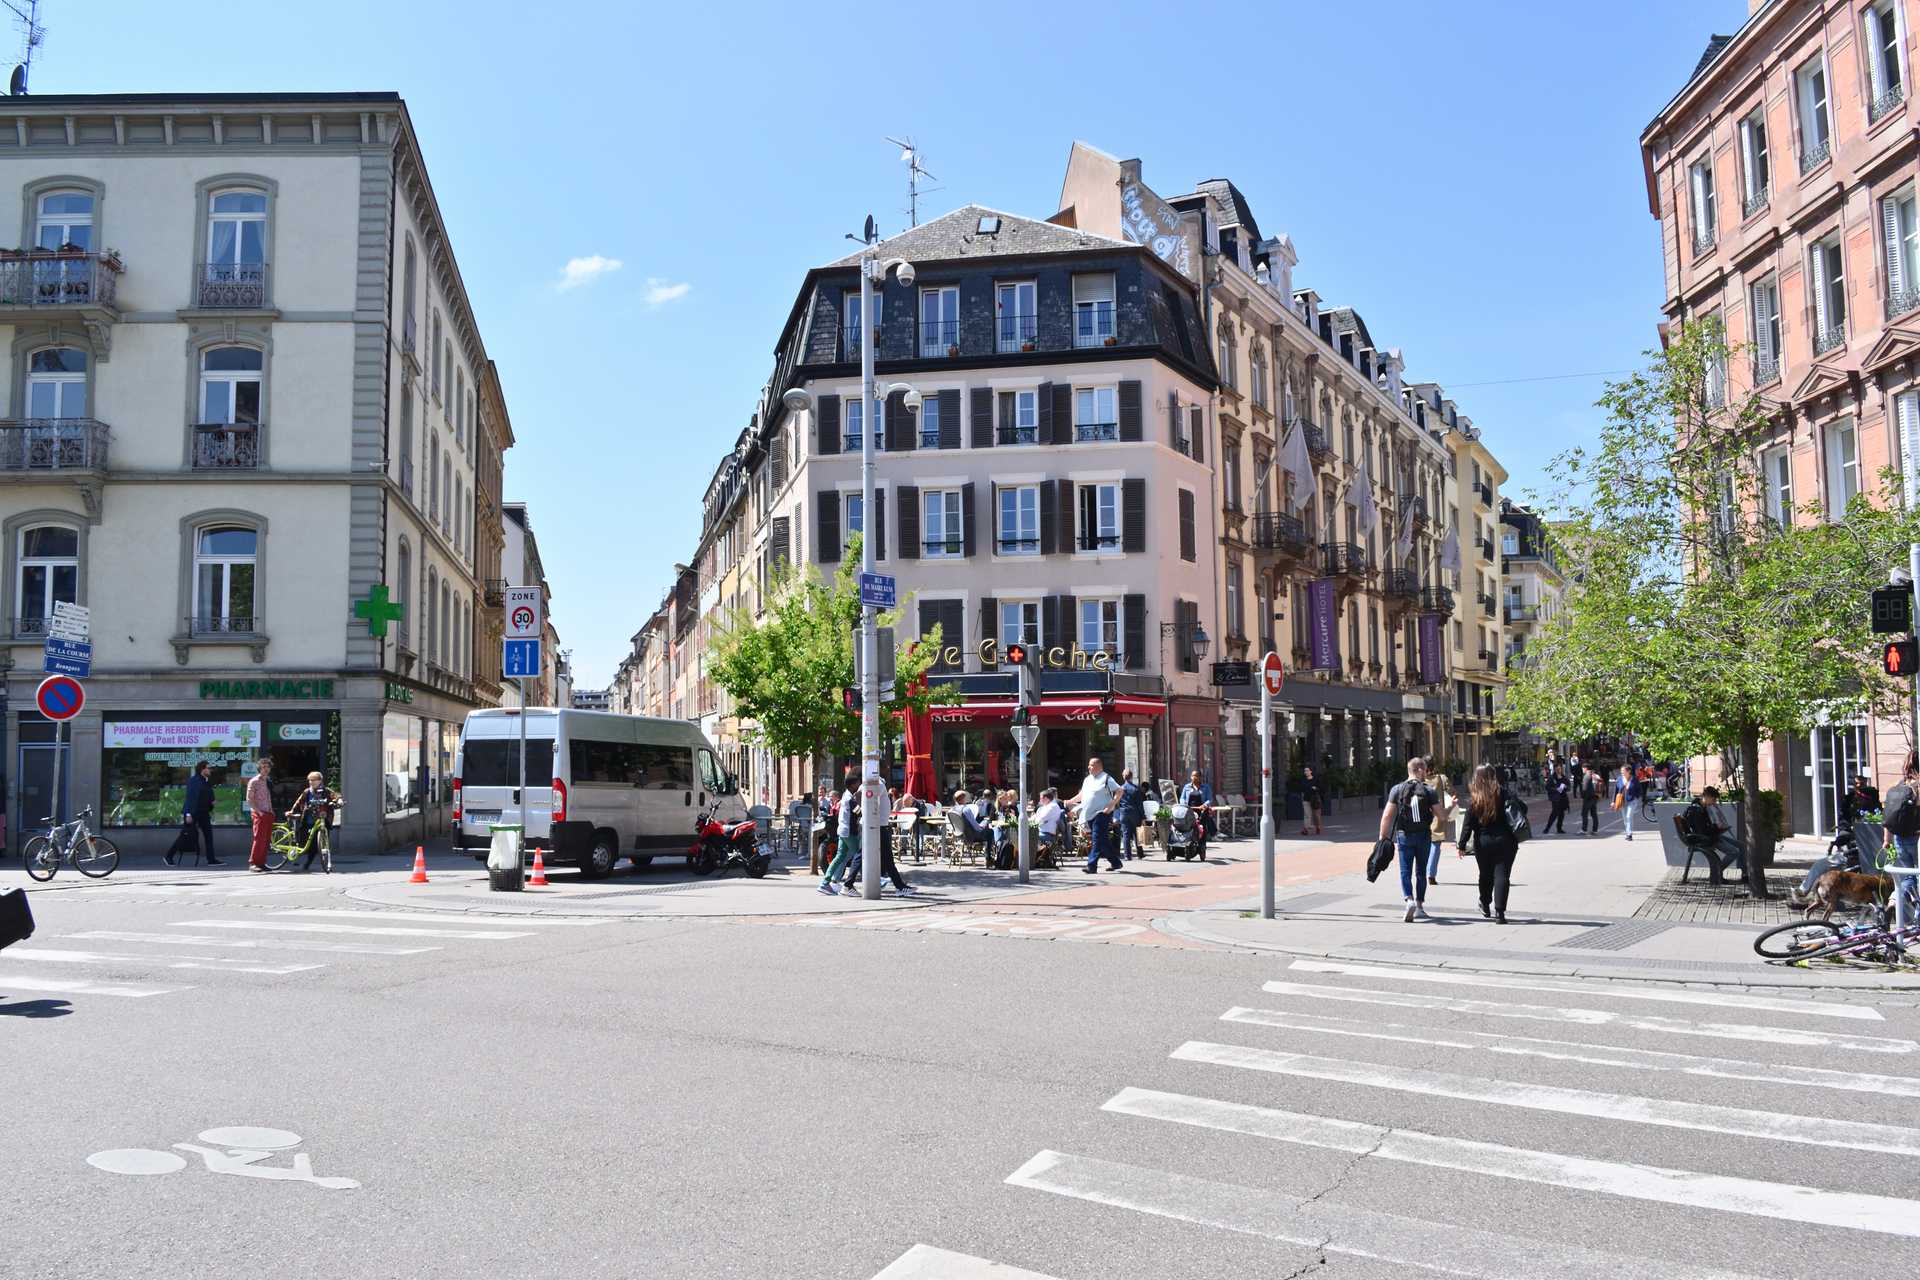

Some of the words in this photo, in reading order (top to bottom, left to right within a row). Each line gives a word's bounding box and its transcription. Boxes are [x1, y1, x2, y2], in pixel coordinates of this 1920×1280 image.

[516, 613, 530, 623] 30
[1320, 616, 1330, 665] Mercure
[200, 679, 334, 699] PHARMACIE
[113, 725, 162, 735] PHARMACIE
[165, 725, 230, 735] HERBORISTERIE
[296, 727, 319, 735] Giphar
[144, 736, 154, 744] du
[156, 736, 175, 744] Pont
[177, 735, 200, 744] KUSS
